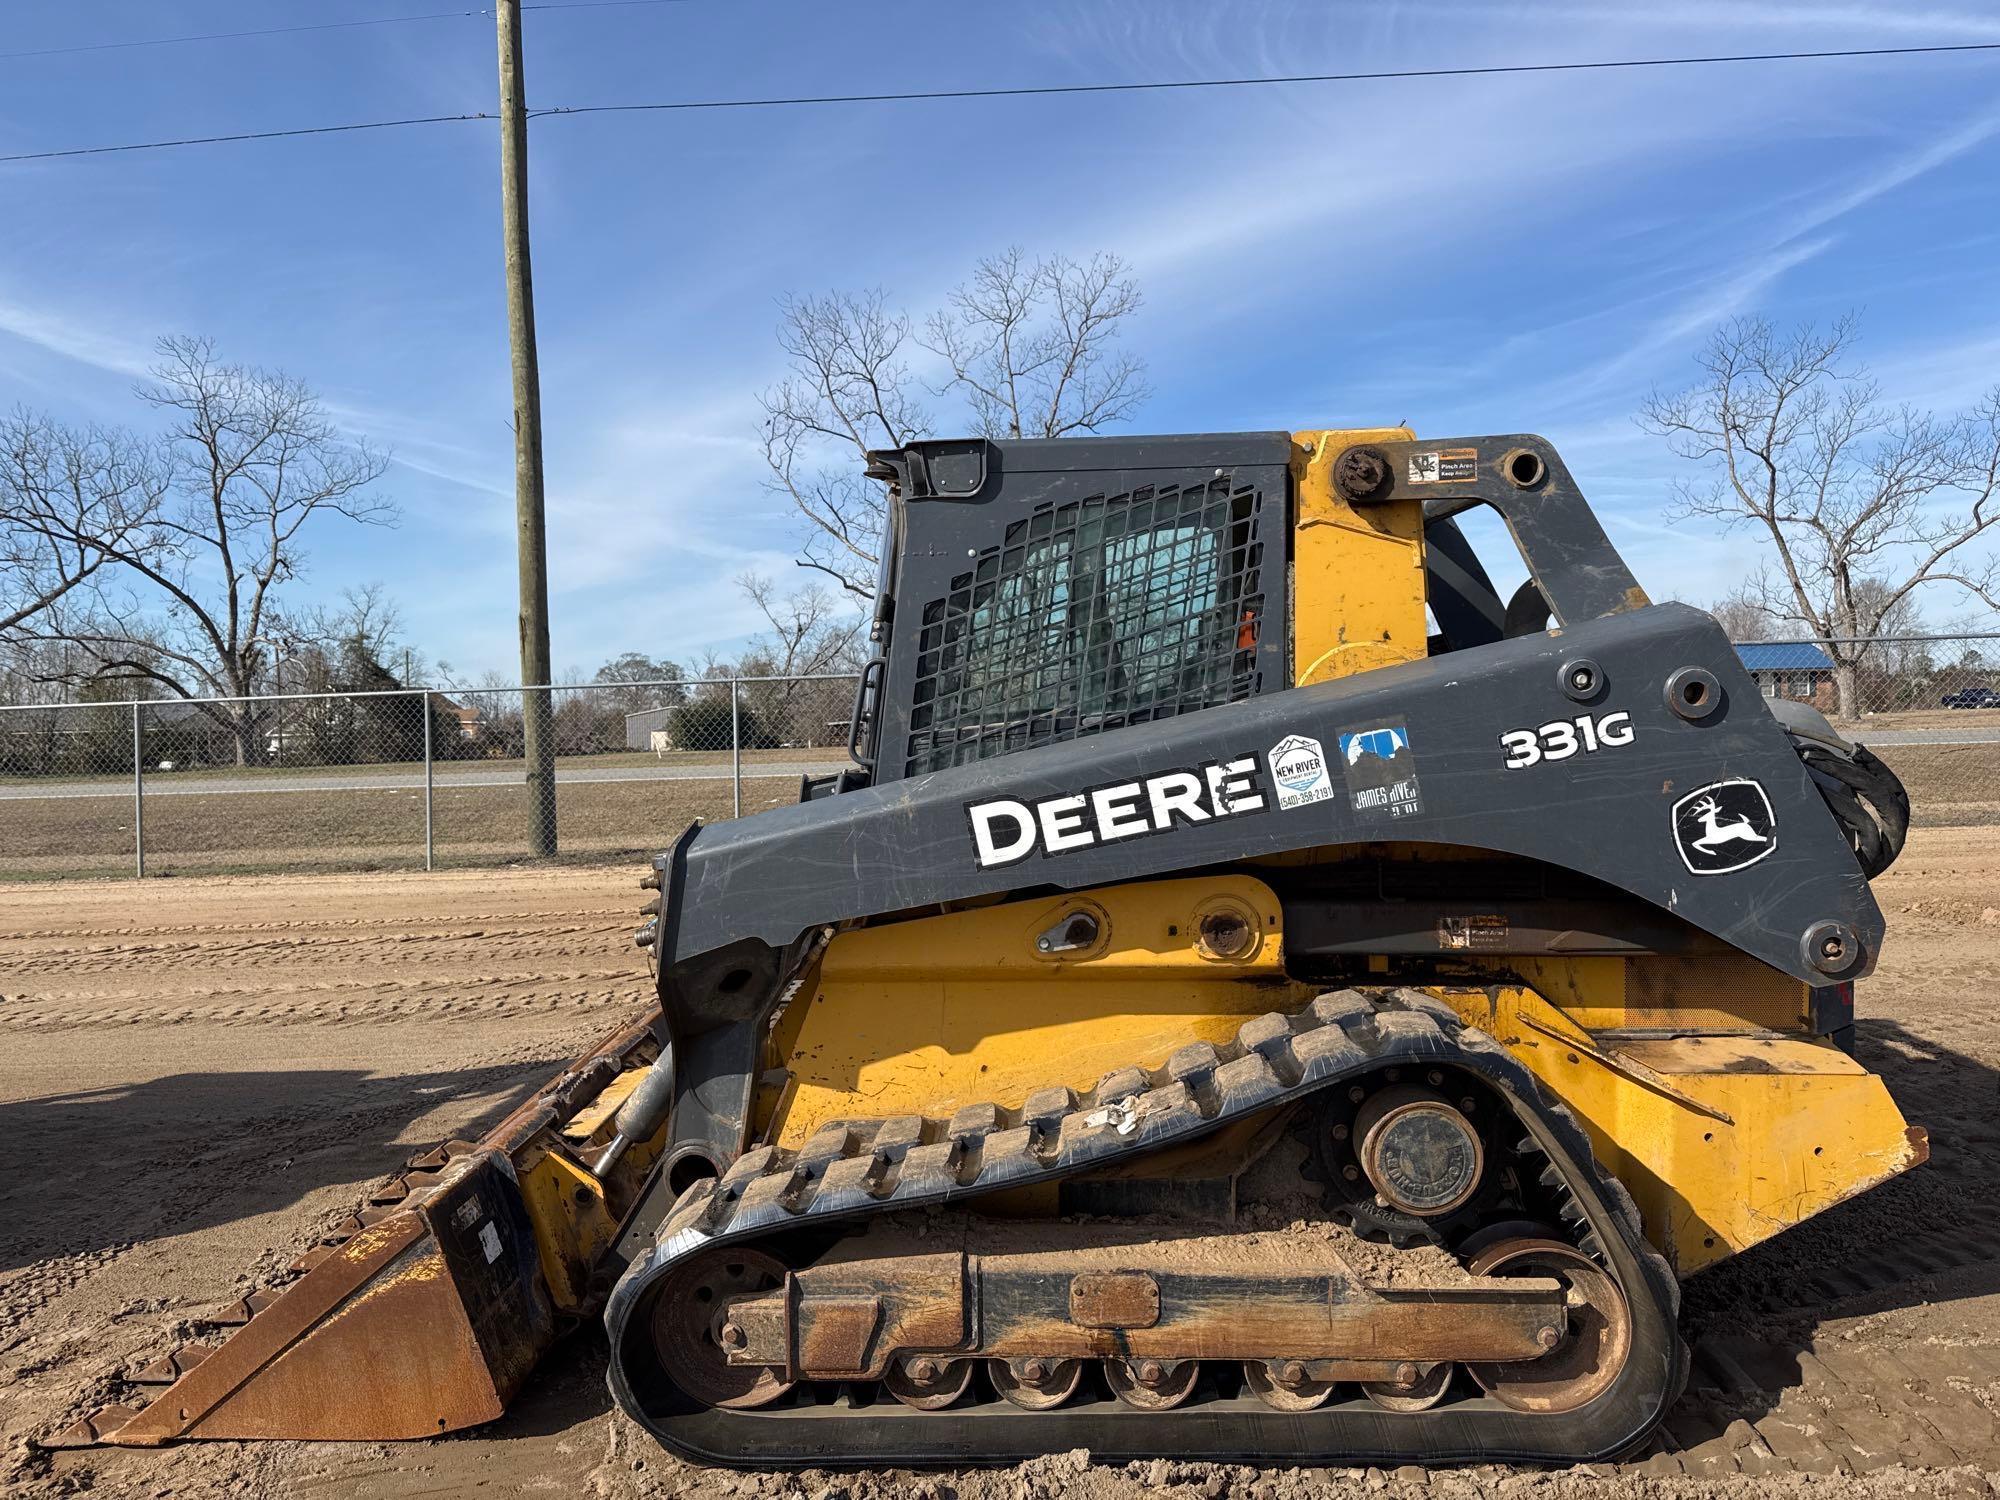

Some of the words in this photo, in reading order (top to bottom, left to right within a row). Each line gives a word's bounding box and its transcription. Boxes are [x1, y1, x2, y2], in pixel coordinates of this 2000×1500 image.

[1500, 712, 1634, 769] 331G
[1275, 764, 1294, 779] NEW
[1295, 758, 1321, 772] RIVER
[1280, 786, 1333, 808] (540)-358-2191
[1356, 786, 1388, 809] JAMES
[969, 757, 1264, 868] DEERE
